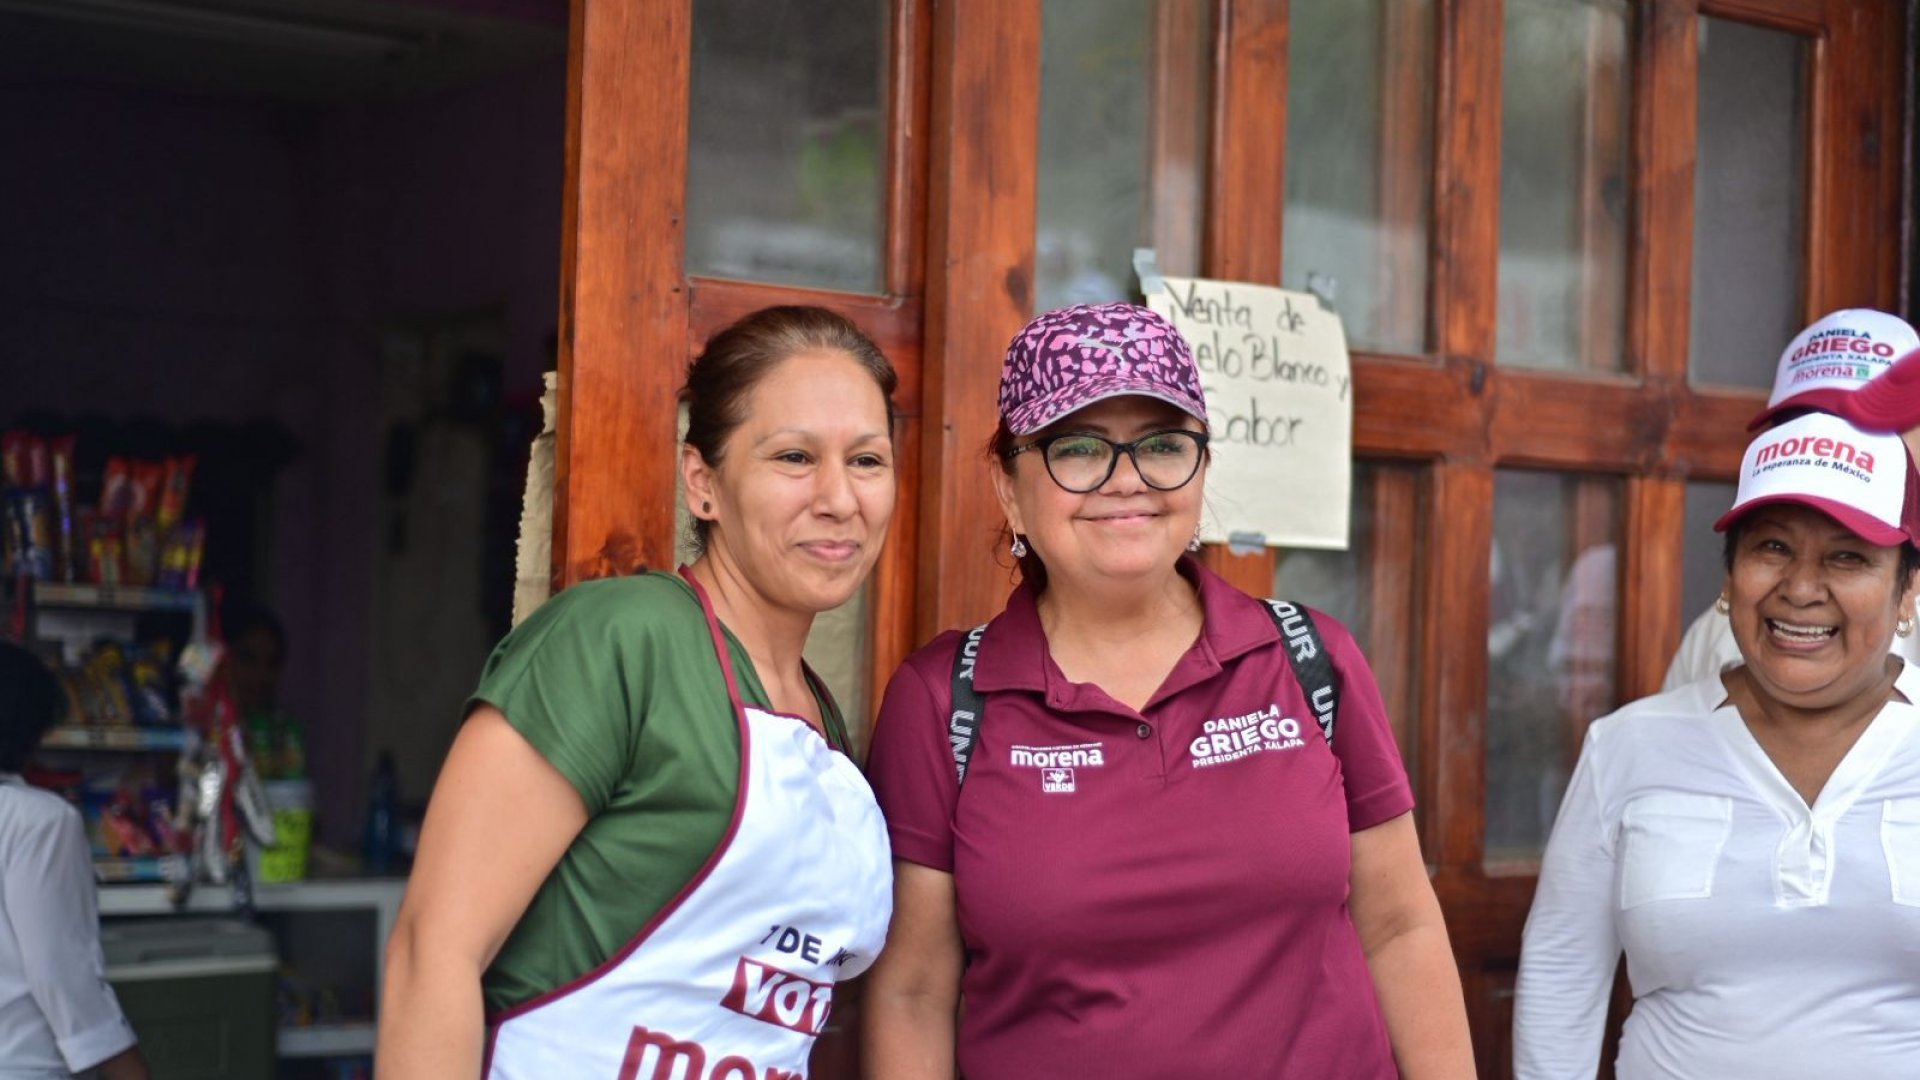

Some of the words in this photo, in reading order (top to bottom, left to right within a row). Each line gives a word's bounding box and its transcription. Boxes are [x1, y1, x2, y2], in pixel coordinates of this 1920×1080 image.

[1163, 281, 1251, 330] Venta
[1277, 297, 1306, 334] de
[1197, 331, 1243, 378] elo
[1243, 333, 1329, 386] Blanco
[1791, 337, 1895, 362] GRIEGO
[1755, 436, 1876, 474] morena
[1762, 459, 1811, 472] esperanza
[1815, 458, 1828, 467] de
[1832, 461, 1871, 483] México
[1190, 718, 1299, 757] GRIEGO
[1203, 704, 1280, 733] DANIELA
[1011, 749, 1104, 767] morena
[1192, 744, 1262, 768] PRESIDENTA
[1264, 738, 1305, 750] XALAPA
[776, 926, 822, 965] DE
[742, 962, 832, 1033] VOT
